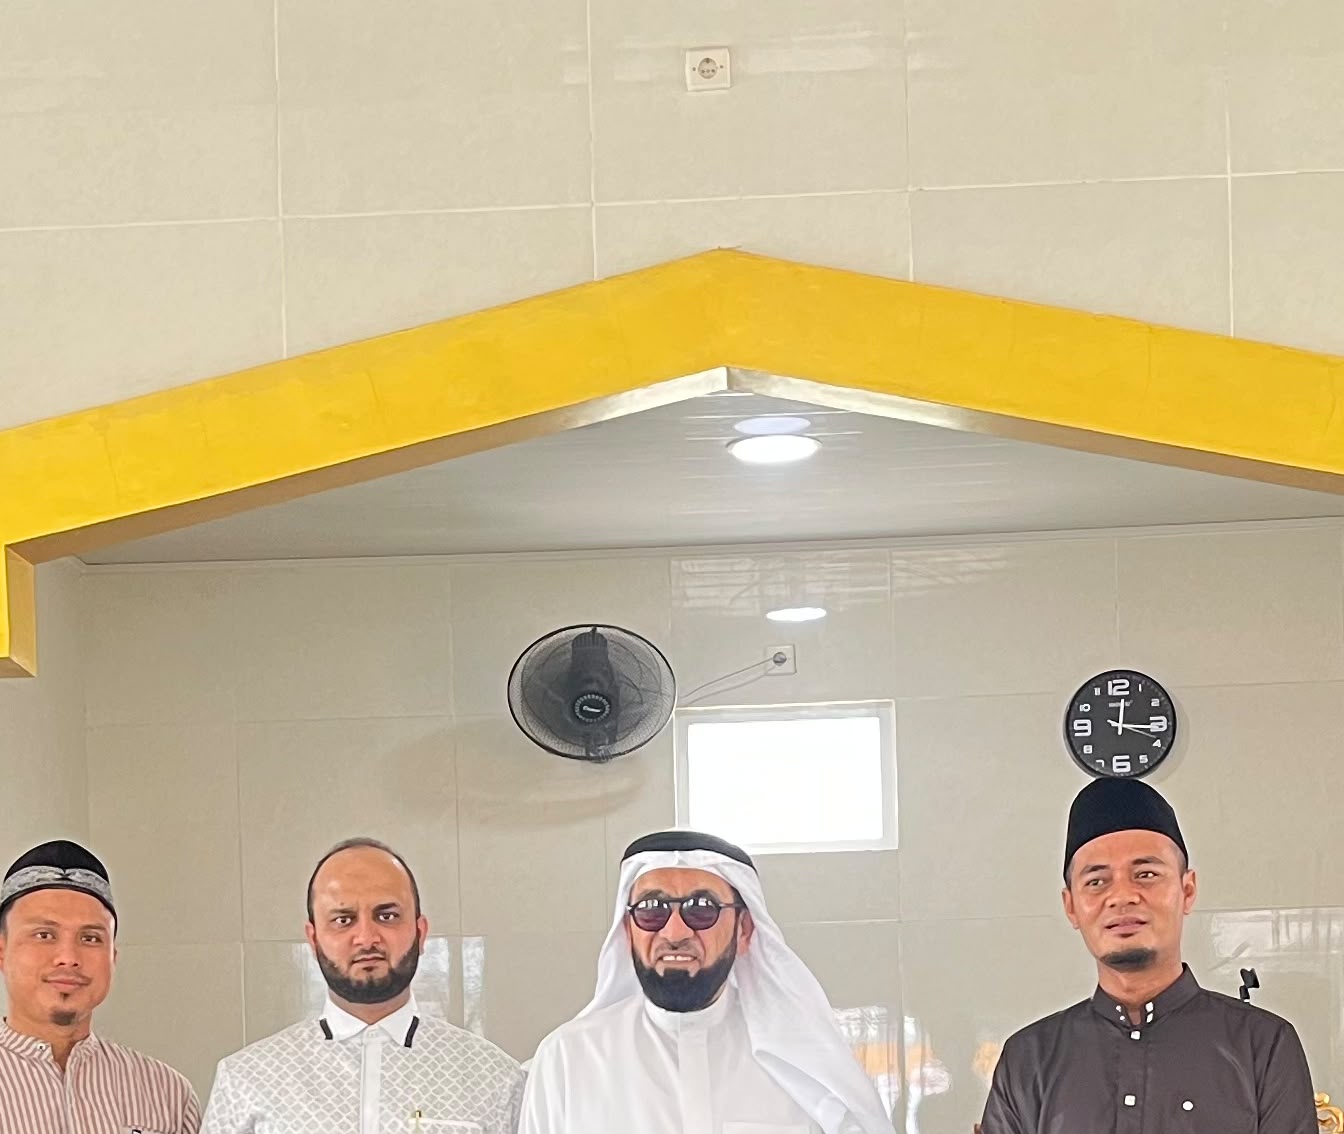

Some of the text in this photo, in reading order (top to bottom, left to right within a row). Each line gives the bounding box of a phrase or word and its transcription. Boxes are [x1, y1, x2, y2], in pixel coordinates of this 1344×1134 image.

[1107, 678, 1130, 696] 12
[1150, 698, 1160, 706] 2
[1073, 719, 1092, 736] 9
[1149, 715, 1168, 732] 3
[1152, 739, 1161, 747] 4
[1095, 759, 1105, 767] 7
[1112, 755, 1131, 773] 6
[1139, 754, 1148, 764] 5
